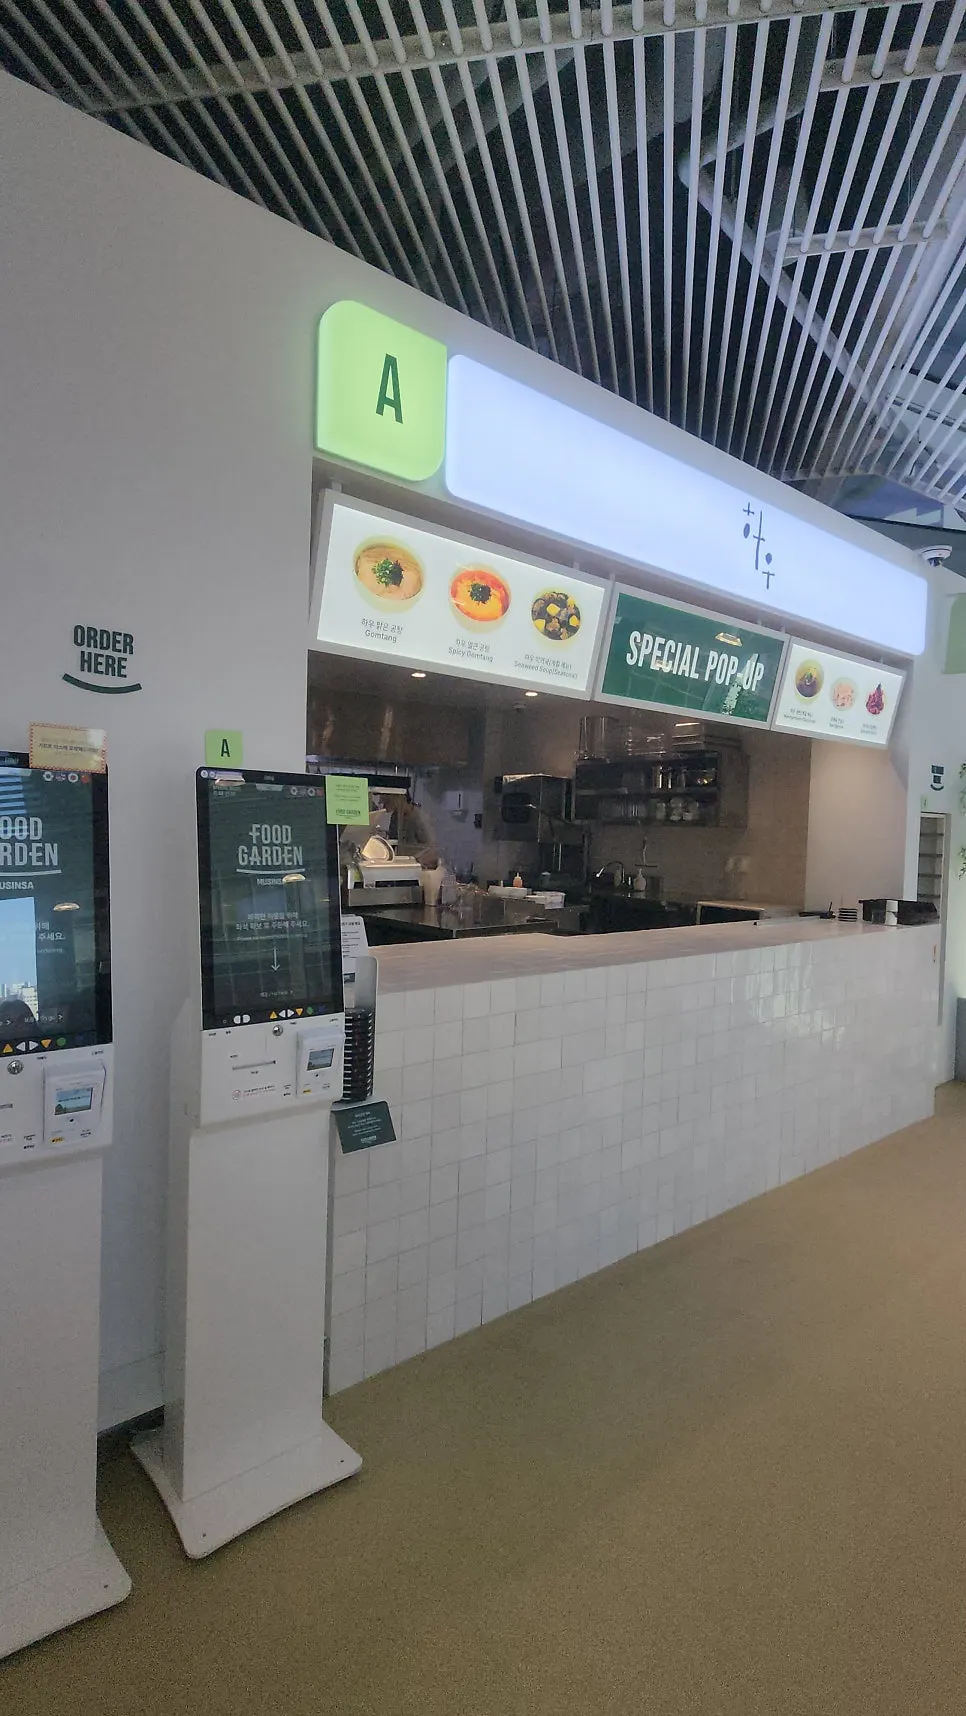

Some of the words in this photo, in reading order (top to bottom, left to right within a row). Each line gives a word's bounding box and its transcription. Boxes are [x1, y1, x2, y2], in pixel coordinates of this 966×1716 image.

[376, 353, 403, 424] A
[73, 624, 134, 655] ORDER
[364, 629, 397, 643] Gomtang
[80, 650, 128, 678] HERE
[448, 646, 466, 657] Spicy
[466, 650, 493, 663] Gomtang
[626, 630, 700, 680] SPECIAL
[704, 650, 765, 692] POP-UP
[220, 739, 231, 758] A
[248, 823, 292, 845] FOOD
[238, 846, 303, 866] GARDEN
